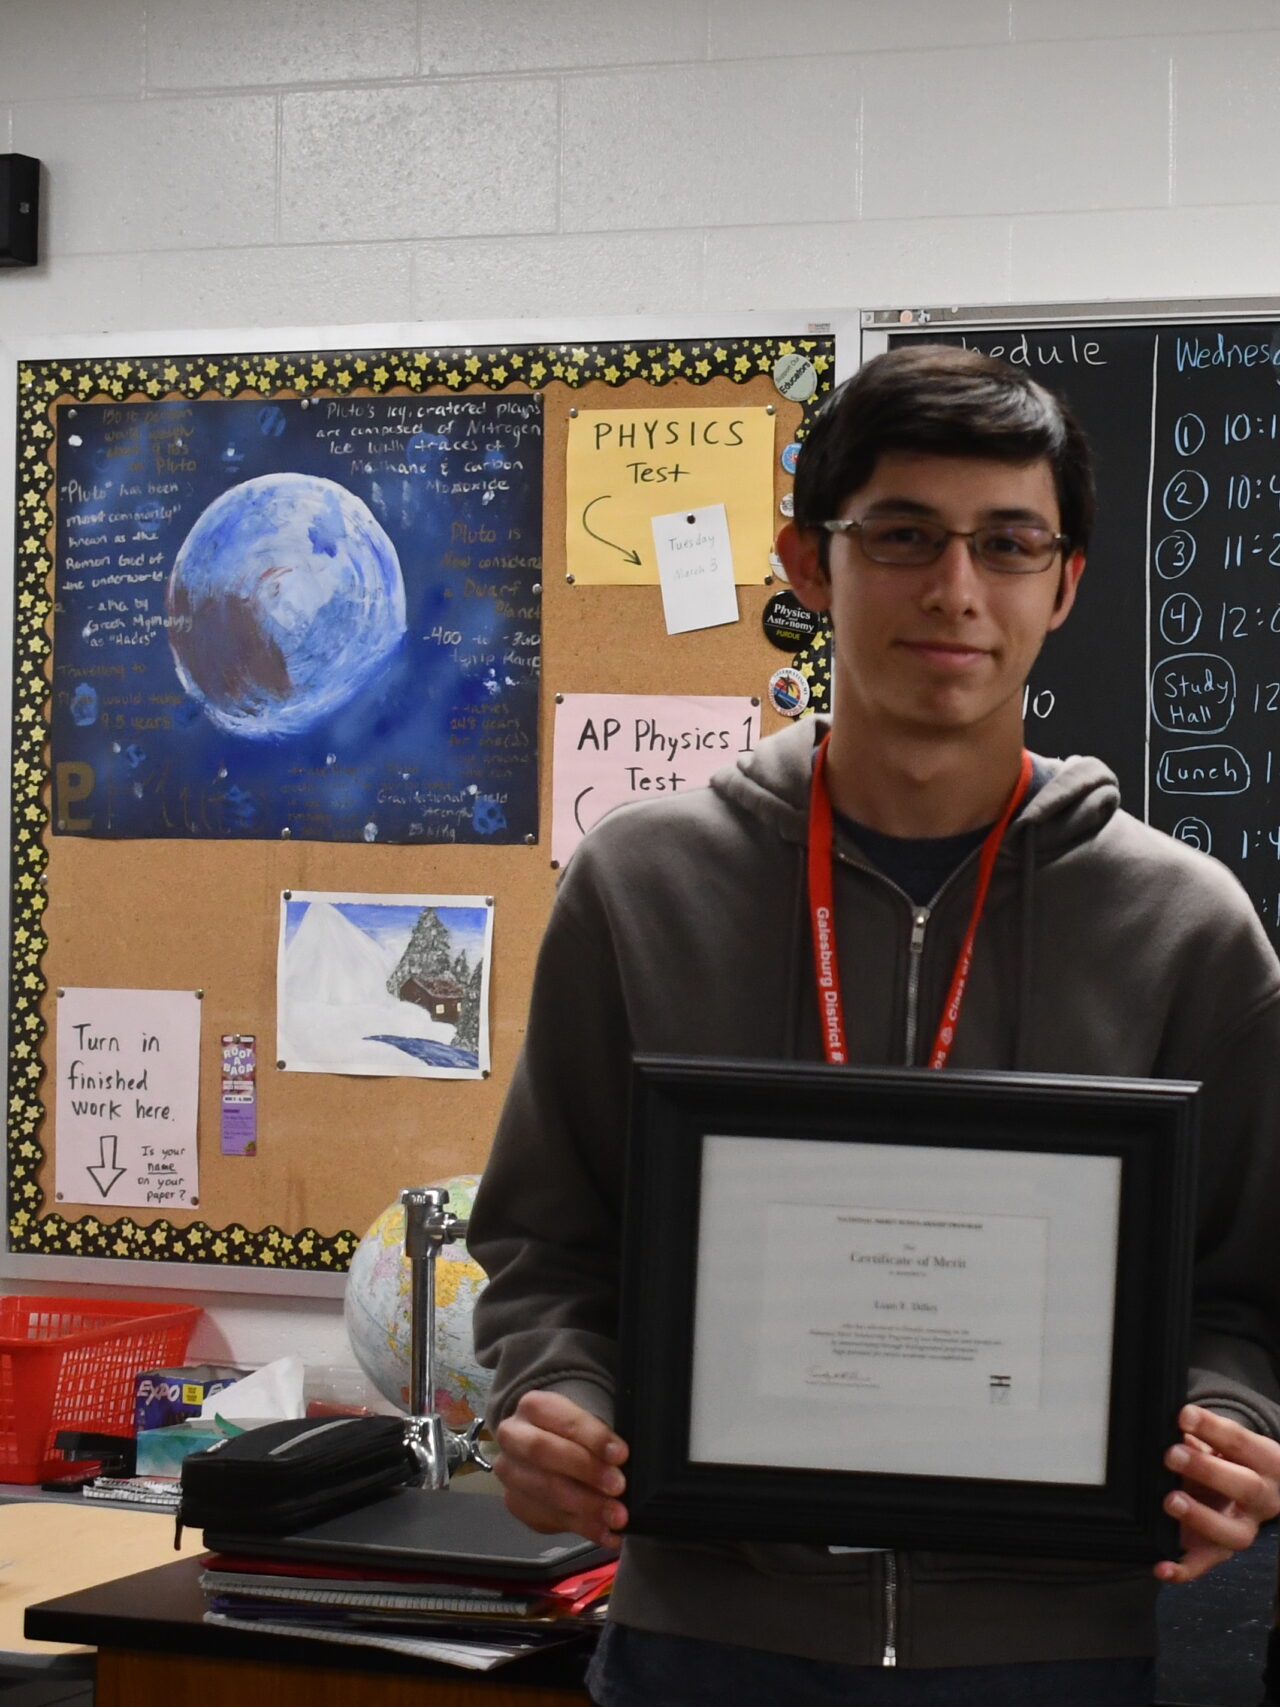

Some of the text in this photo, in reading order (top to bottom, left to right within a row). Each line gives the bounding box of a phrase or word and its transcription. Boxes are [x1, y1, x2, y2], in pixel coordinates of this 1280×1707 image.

[962, 334, 1107, 367] hedule
[779, 361, 811, 395] Educators
[417, 401, 486, 417] cratered
[315, 429, 340, 439] are
[437, 420, 455, 435] of
[466, 420, 541, 448] Nitrogen
[594, 420, 744, 450] PHYSICS
[414, 440, 478, 452] traces
[626, 462, 691, 484] Test
[451, 521, 497, 543] Pluto
[668, 533, 715, 551] Tuesday
[65, 555, 110, 570] Roman
[709, 557, 719, 573] 3
[773, 602, 811, 621] Physics
[776, 629, 801, 641] PURDUE
[1164, 669, 1229, 703] Study
[1170, 705, 1212, 725] Hall
[577, 716, 754, 762] AP Physics 1
[624, 767, 686, 791] Test
[1163, 755, 1238, 783] Lunch
[816, 907, 833, 987] Galesburg
[824, 991, 842, 1048] District
[72, 1023, 160, 1052] Turn in
[223, 1047, 253, 1059] ROOT
[234, 1057, 241, 1065] A
[68, 1059, 148, 1091] finished
[71, 1098, 175, 1122] work here.
[141, 1145, 186, 1160] Is your
[147, 1162, 176, 1172] name
[137, 1177, 184, 1190] on your
[136, 1379, 180, 1406] EXPO
